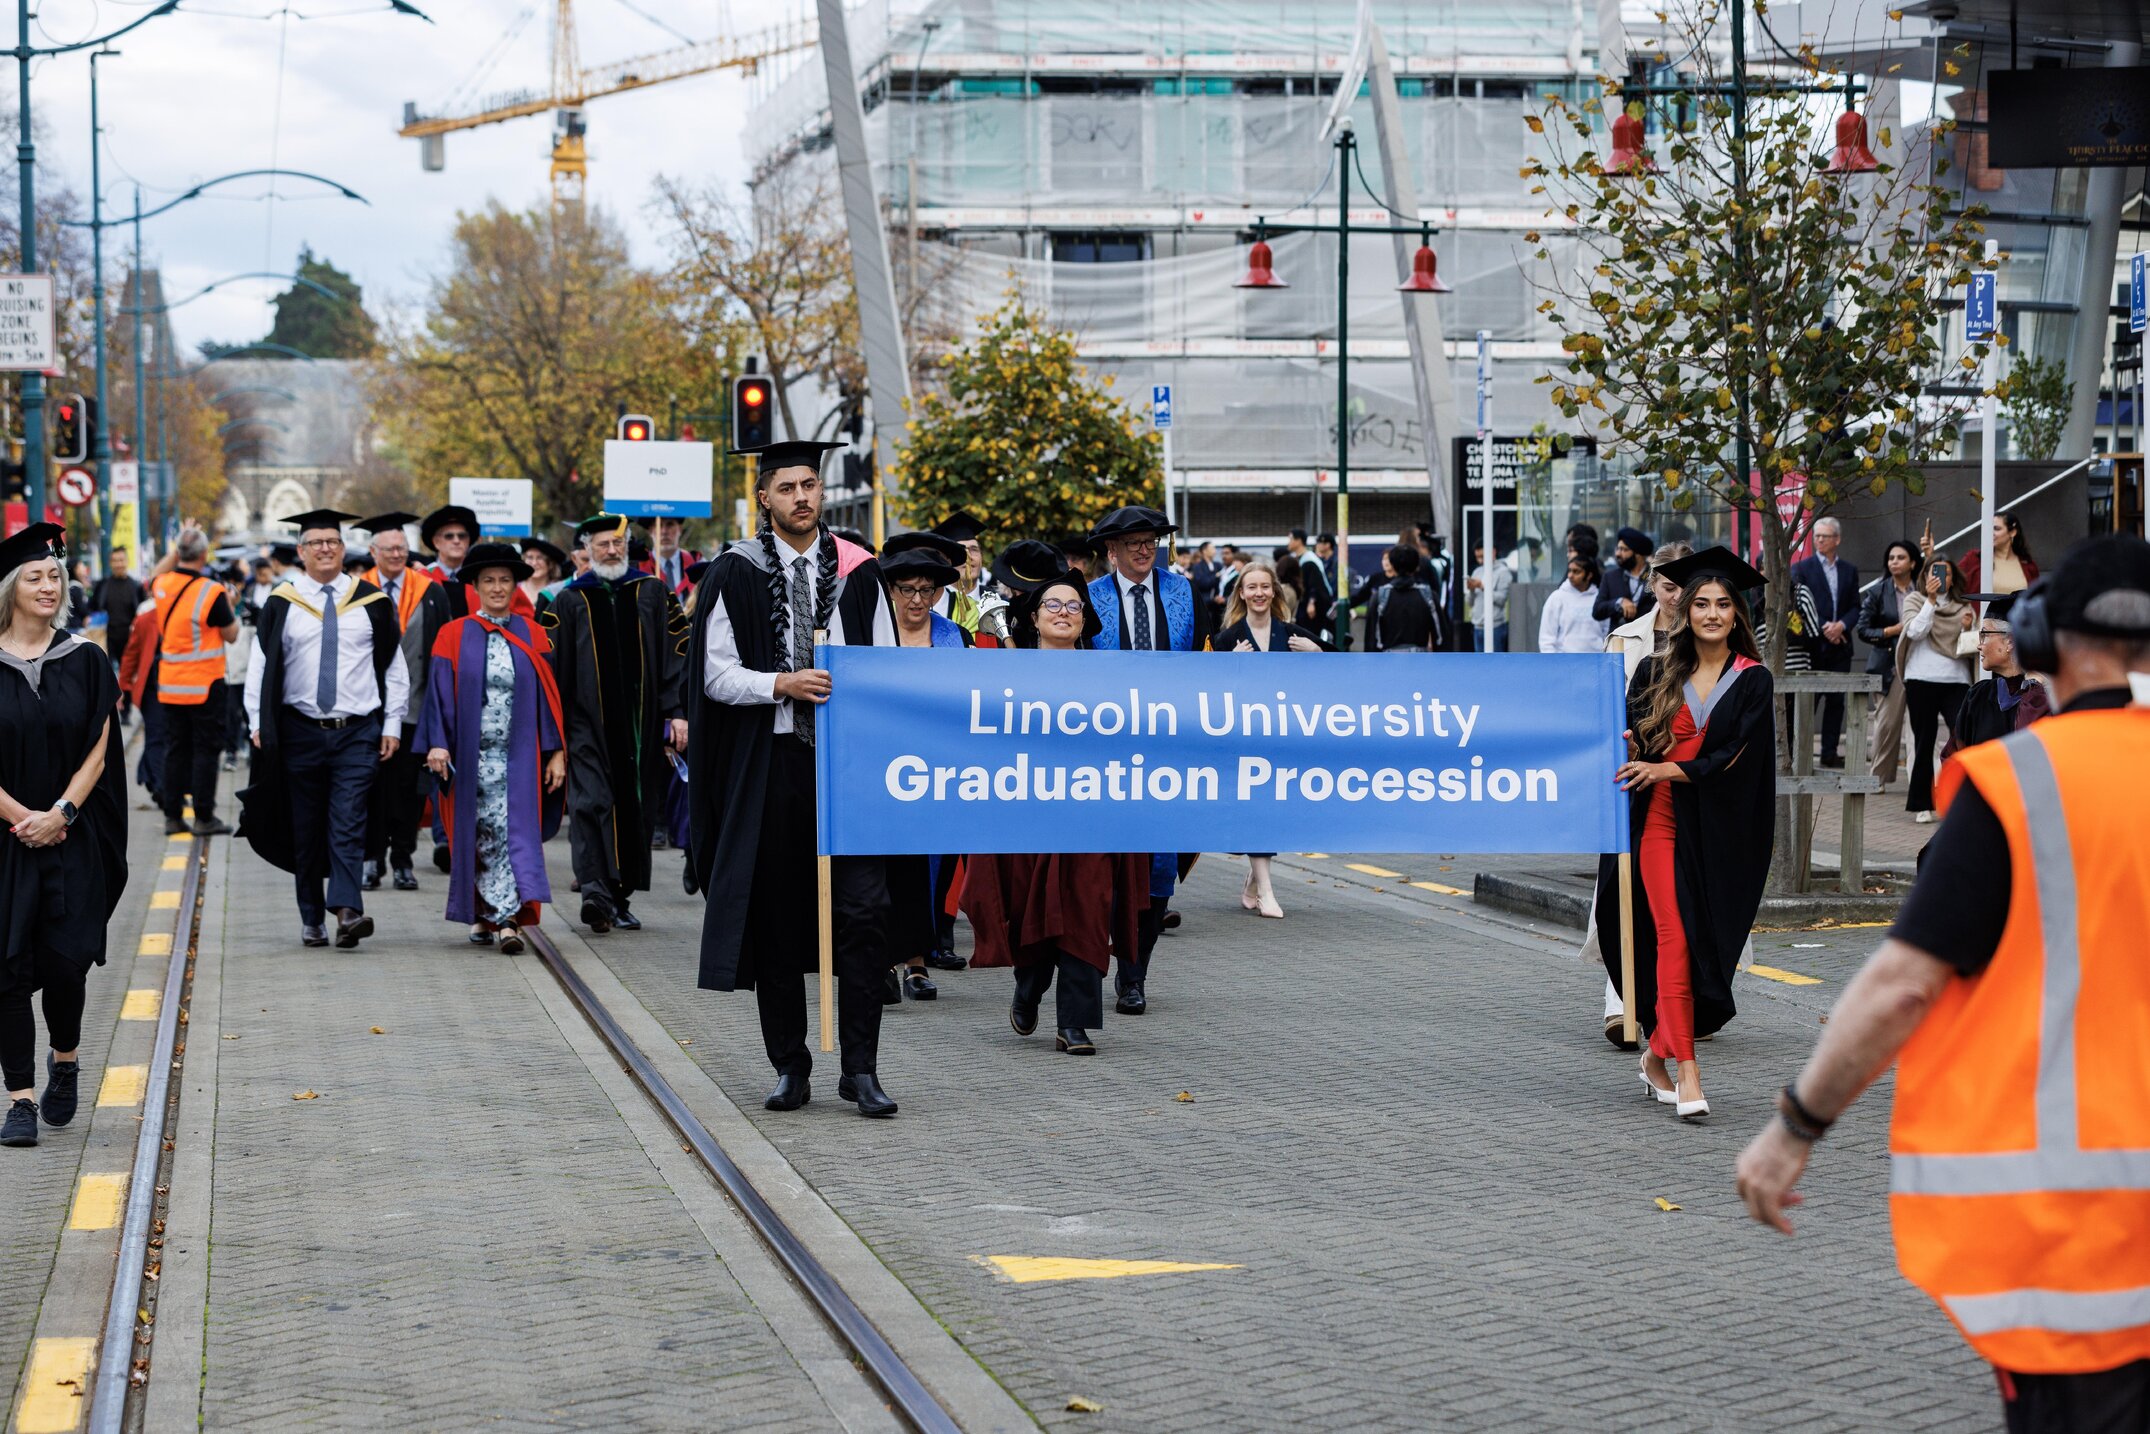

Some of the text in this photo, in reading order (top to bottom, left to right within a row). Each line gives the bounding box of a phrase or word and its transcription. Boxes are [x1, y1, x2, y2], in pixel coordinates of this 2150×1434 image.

[2109, 144, 2150, 154] PEACOC
[2135, 260, 2141, 283] P
[8, 281, 24, 295] NO
[1975, 276, 1985, 299] P
[1977, 301, 1983, 318] 5
[1, 315, 31, 329] ZONE
[1982, 320, 1992, 328] Time
[649, 467, 667, 476] PhD
[1466, 467, 1480, 477] TE
[971, 687, 1481, 748] Lincoln University
[885, 753, 1558, 802] Graduation Procession
